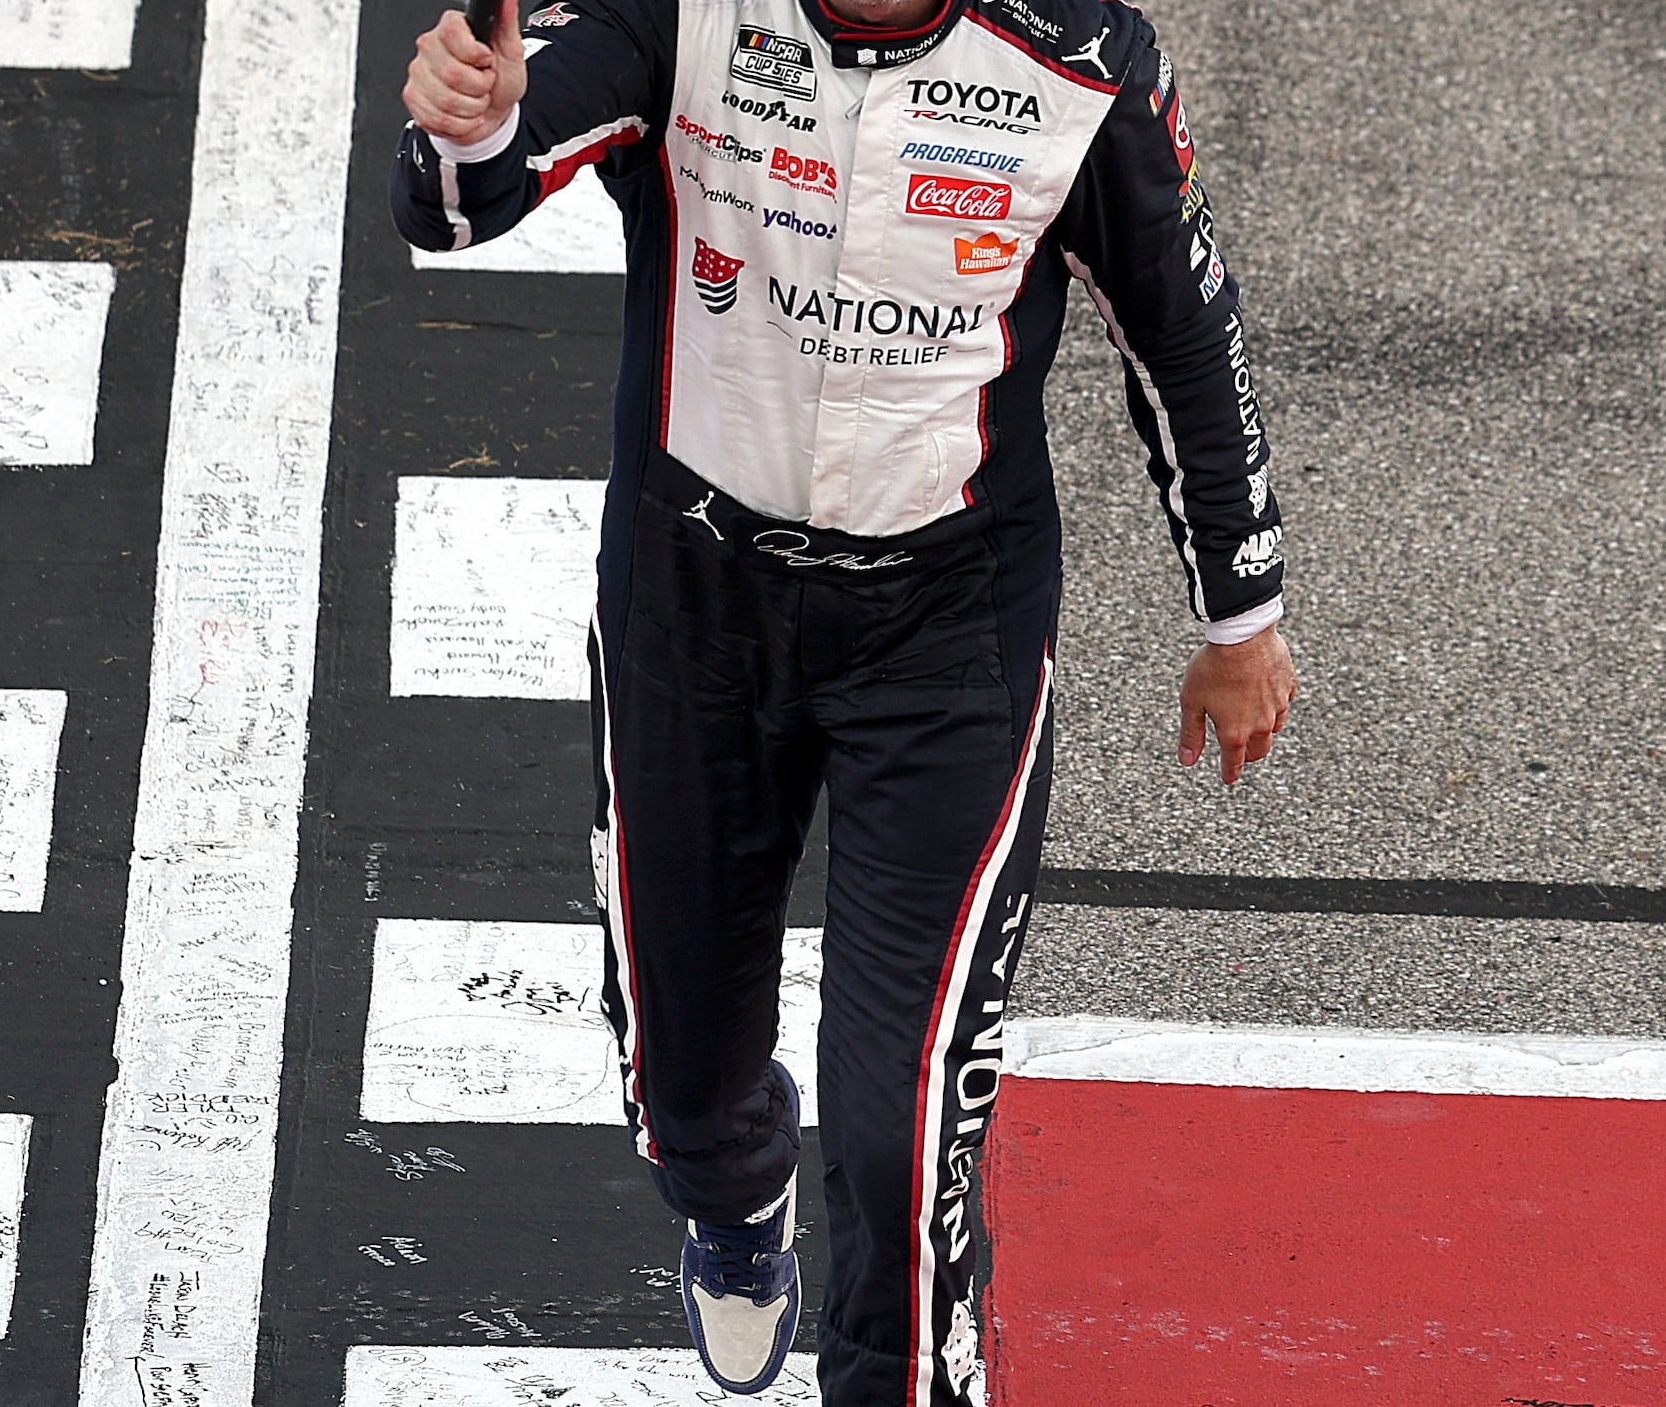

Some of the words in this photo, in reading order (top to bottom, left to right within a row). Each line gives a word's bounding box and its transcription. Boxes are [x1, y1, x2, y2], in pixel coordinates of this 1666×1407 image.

[745, 56, 771, 73] CUP
[907, 79, 1042, 123] TOYOTA
[904, 109, 1040, 135] RACING
[771, 147, 838, 190] BOB'S
[900, 142, 1023, 173] PROGRESSIVE
[910, 180, 1009, 219] Coca-Cola
[762, 207, 838, 239] yahoo!
[959, 256, 1010, 270] Hawaiian
[971, 246, 1001, 260] King's
[768, 275, 983, 339] NATIONAL
[800, 337, 864, 365] DEBT
[869, 346, 948, 366] RELIEF
